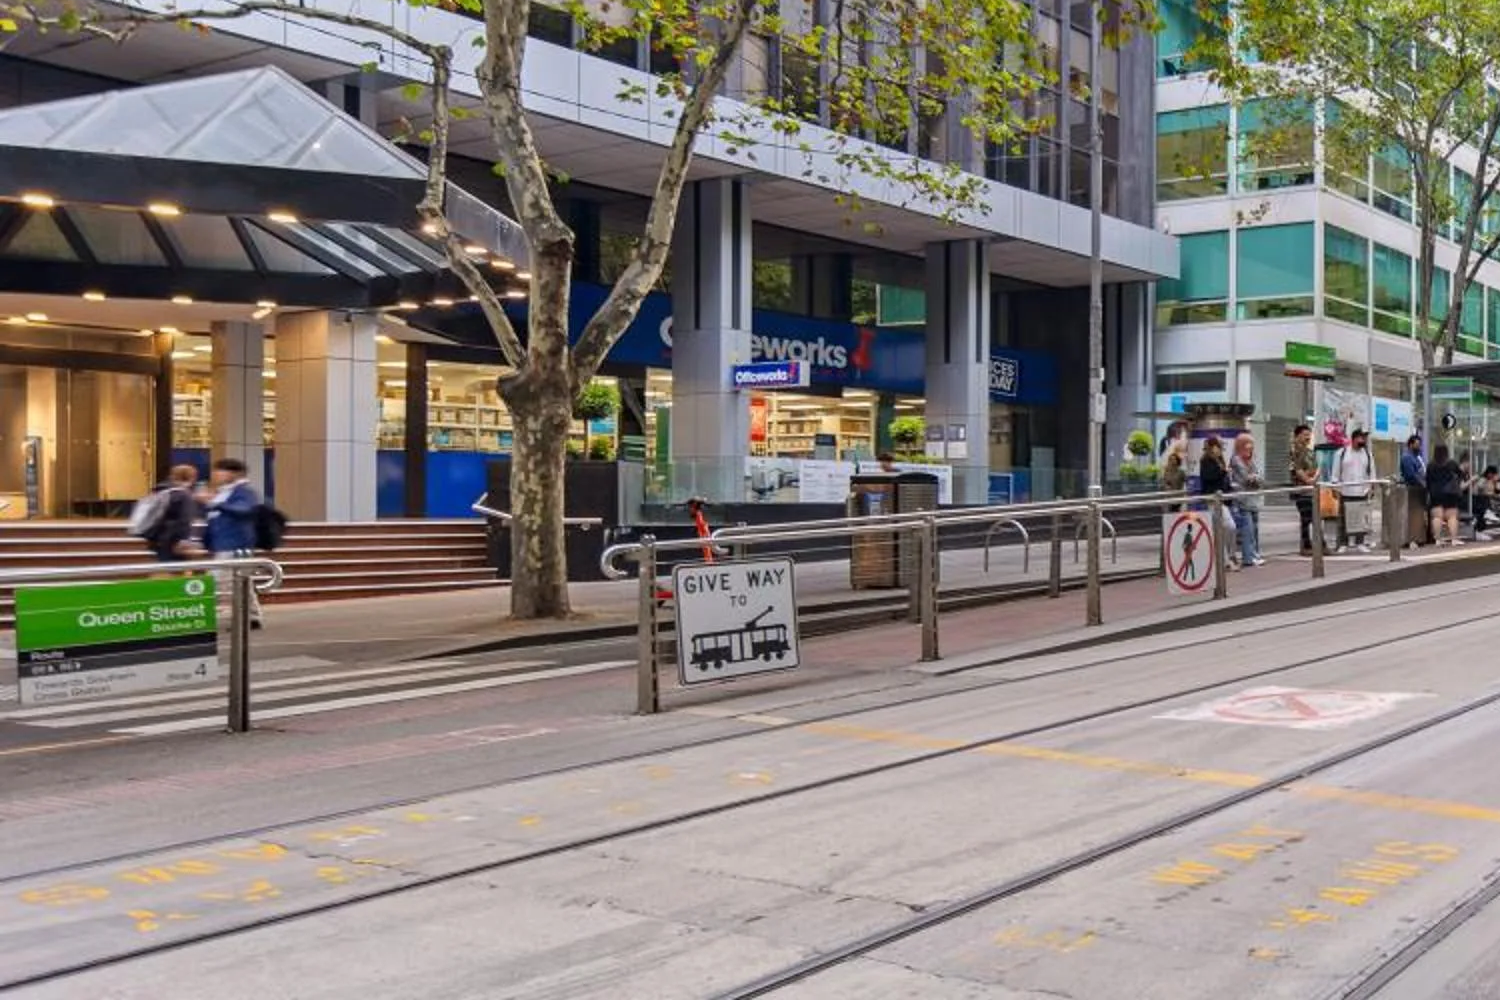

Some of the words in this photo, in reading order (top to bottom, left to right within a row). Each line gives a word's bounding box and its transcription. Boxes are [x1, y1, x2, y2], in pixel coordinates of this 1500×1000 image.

[683, 573, 731, 594] GIVE
[745, 568, 785, 588] WAY
[730, 595, 747, 608] TO
[78, 611, 145, 628] Queen
[149, 603, 206, 621] Street
[194, 663, 207, 676] 4
